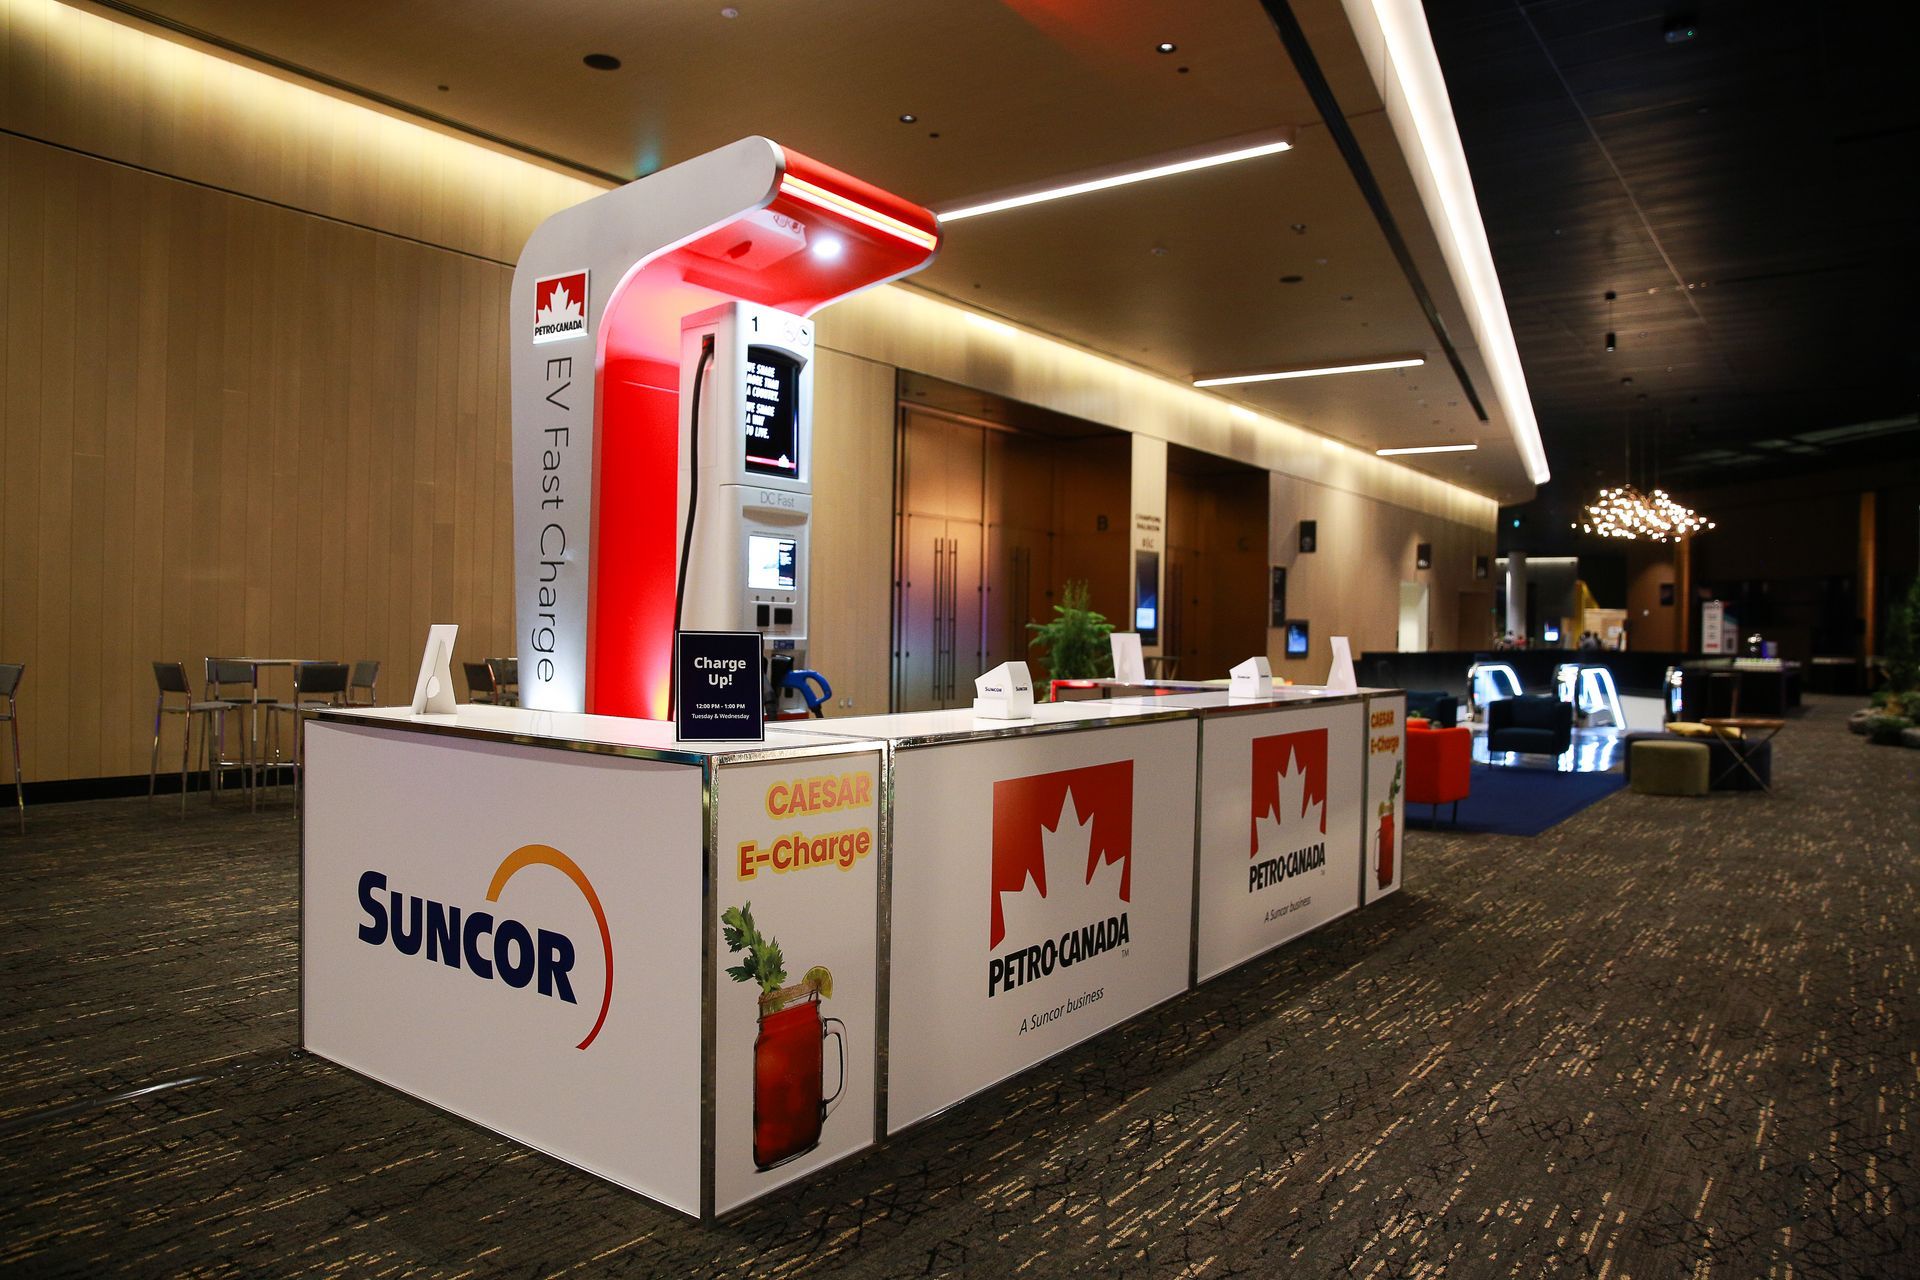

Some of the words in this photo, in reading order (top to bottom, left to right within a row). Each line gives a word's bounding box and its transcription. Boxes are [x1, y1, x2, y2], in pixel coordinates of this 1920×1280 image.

[534, 319, 583, 337] PETRO-CANADA
[752, 316, 758, 332] 1
[546, 356, 572, 411] EV
[541, 427, 569, 510] Fast
[760, 491, 775, 505] DC
[778, 494, 795, 508] Fast
[531, 523, 565, 683] Charge
[694, 656, 747, 672] Charge
[708, 673, 733, 689] Up!
[768, 773, 871, 817] CAESAR
[740, 830, 871, 879] E-Charge
[1249, 842, 1326, 893] PETRO-CANADA
[1264, 912, 1270, 924] A
[1270, 904, 1290, 921] Suncor
[1289, 896, 1312, 913] business
[358, 870, 578, 1005] SUNCOR
[988, 912, 1130, 999] PETRO-CANADA
[1018, 1018, 1028, 1036] A
[1030, 1005, 1065, 1031] Suncor
[1066, 987, 1105, 1014] business
